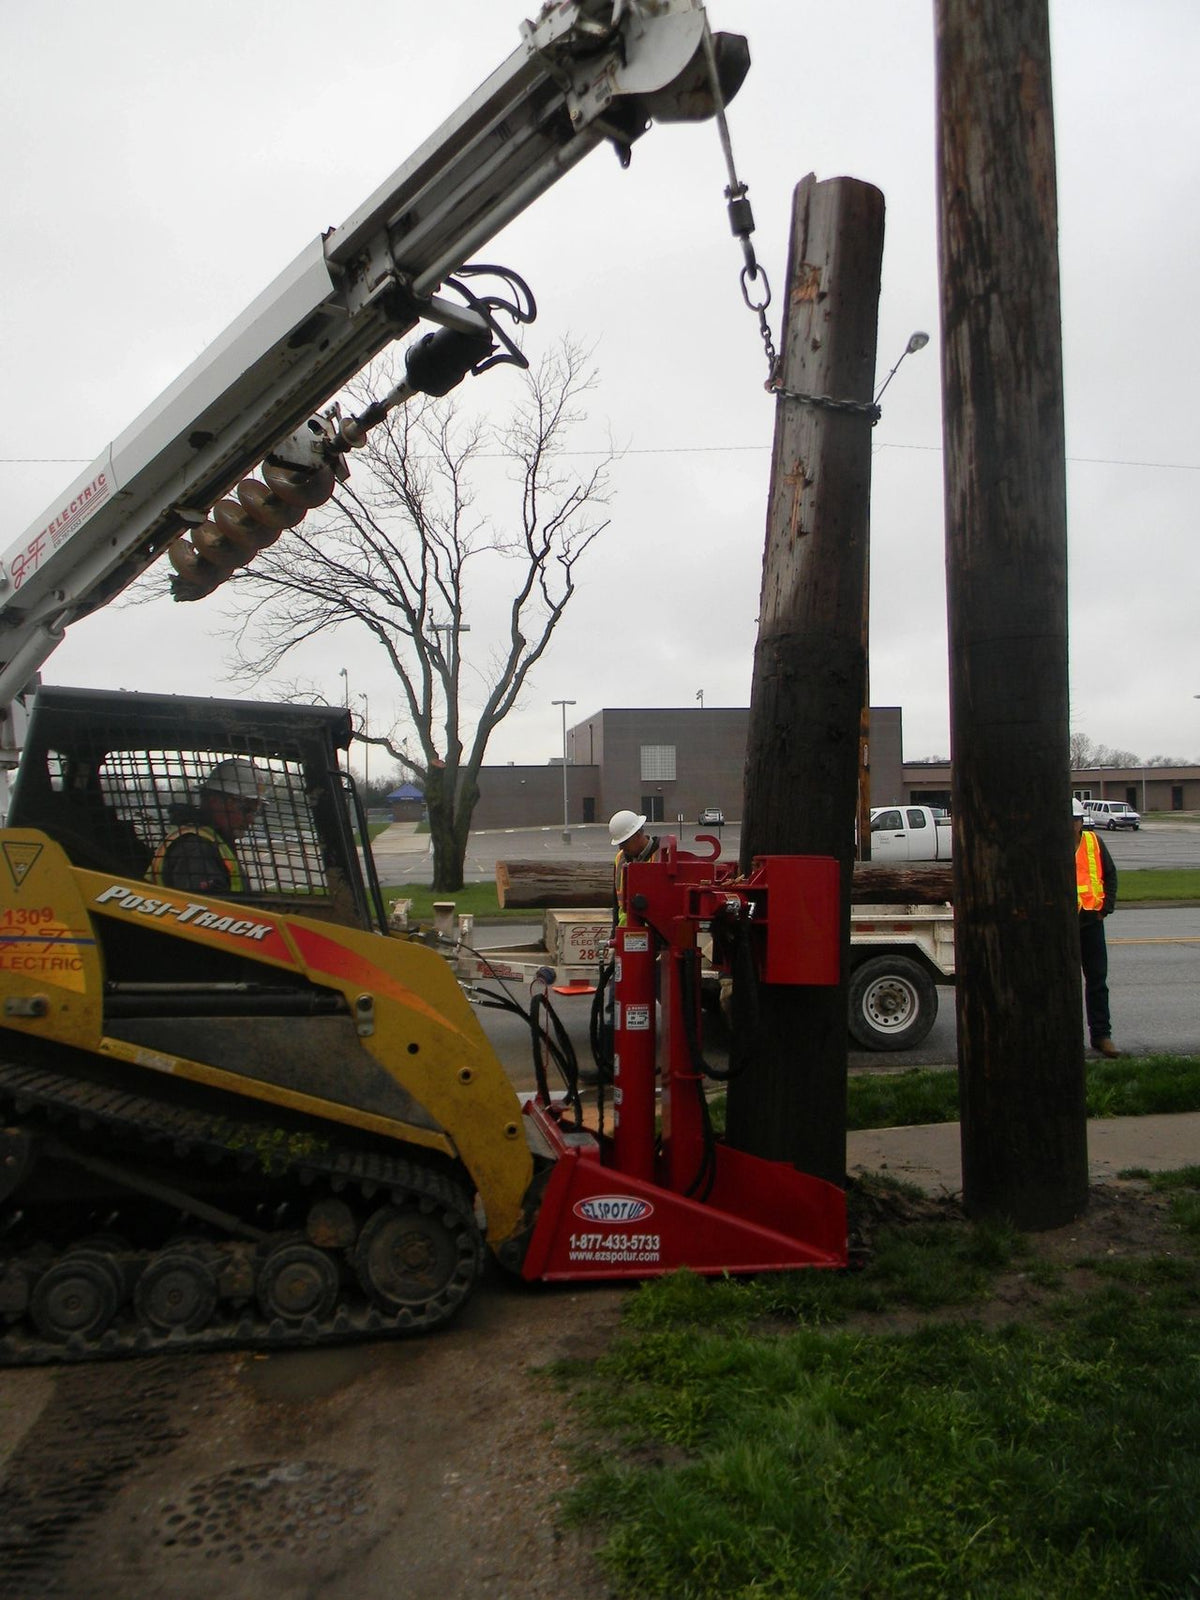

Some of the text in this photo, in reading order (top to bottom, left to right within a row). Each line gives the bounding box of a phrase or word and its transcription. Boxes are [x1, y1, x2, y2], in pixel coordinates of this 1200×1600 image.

[48, 473, 106, 535] ELECTRIC
[3, 906, 54, 926] 1309
[0, 956, 83, 971] LECTRIC
[581, 1202, 599, 1219] EZ
[599, 1202, 628, 1219] SPOT
[569, 1233, 660, 1250] 1-877-433-5733
[569, 1251, 660, 1263] www.ezspotur.com
